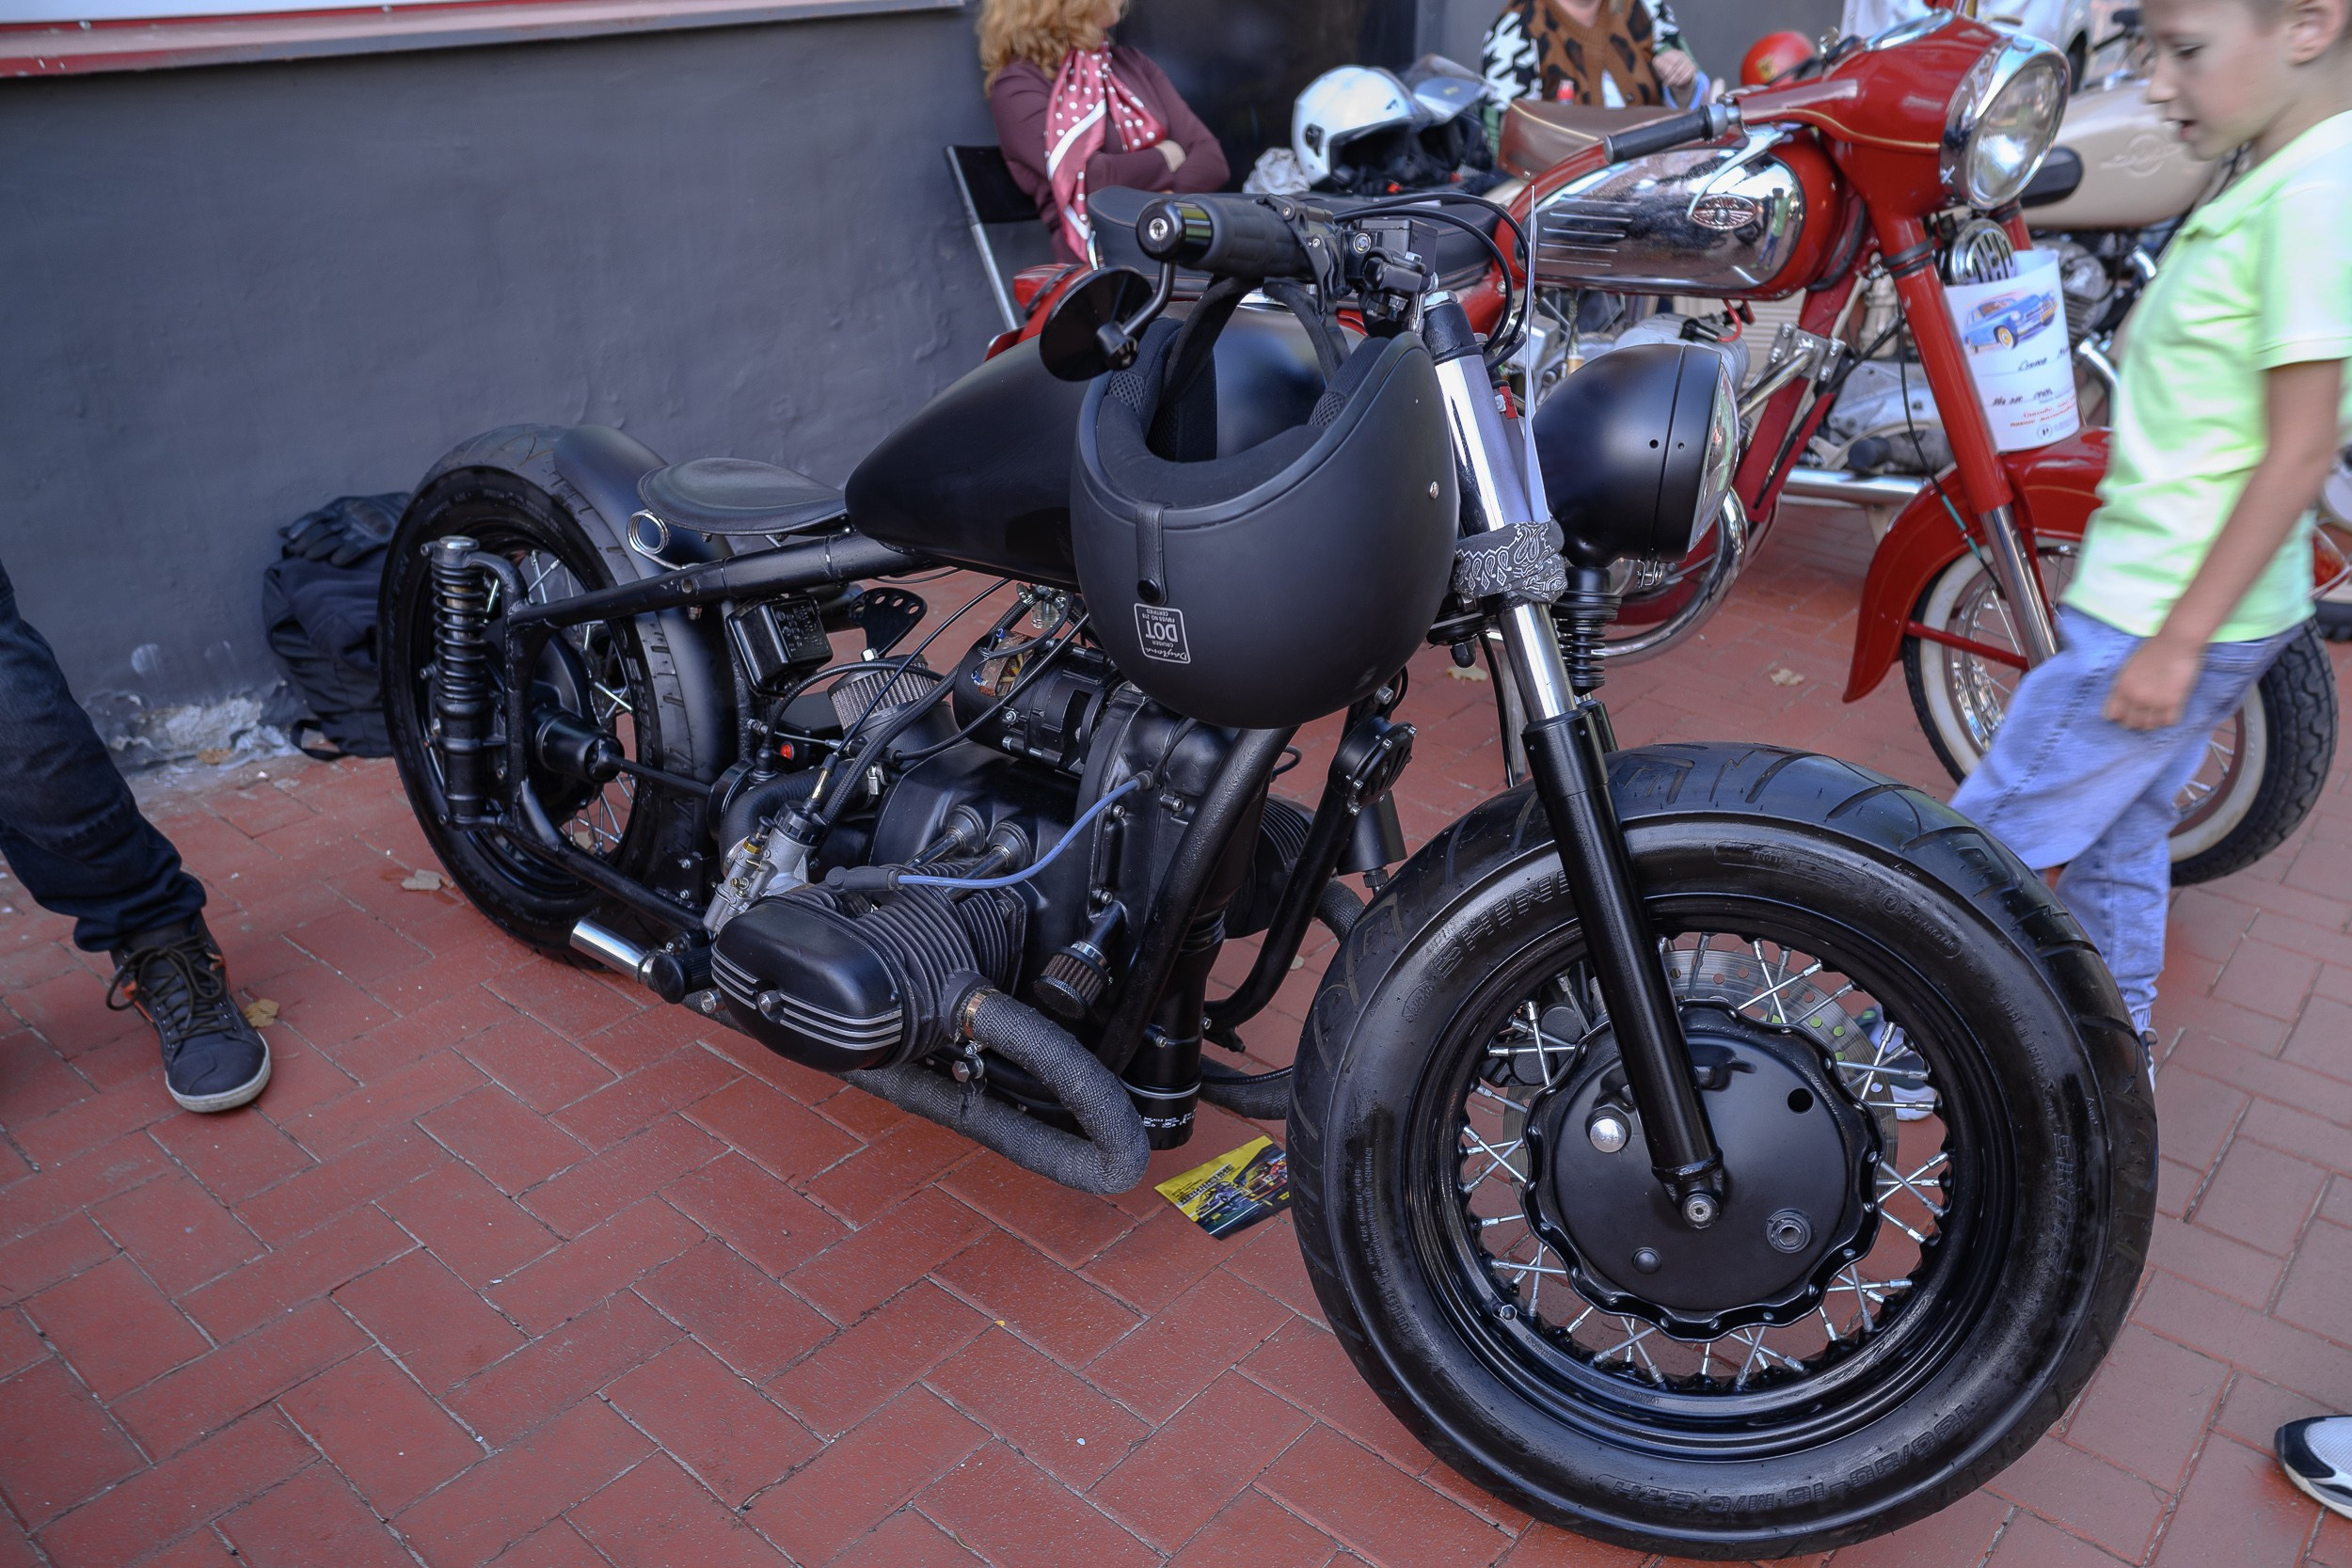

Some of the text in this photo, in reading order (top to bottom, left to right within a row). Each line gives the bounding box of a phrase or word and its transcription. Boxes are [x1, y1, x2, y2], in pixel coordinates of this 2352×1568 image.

[1145, 620, 1178, 642] DOT
[1145, 647, 1187, 660] Daytona
[1152, 640, 1174, 648] CRUISER
[1753, 851, 1782, 863] FRONT
[1432, 869, 1570, 979] SHIN
[1383, 1288, 1413, 1334] TUBELESS
[1708, 1492, 1776, 1513] M/C
